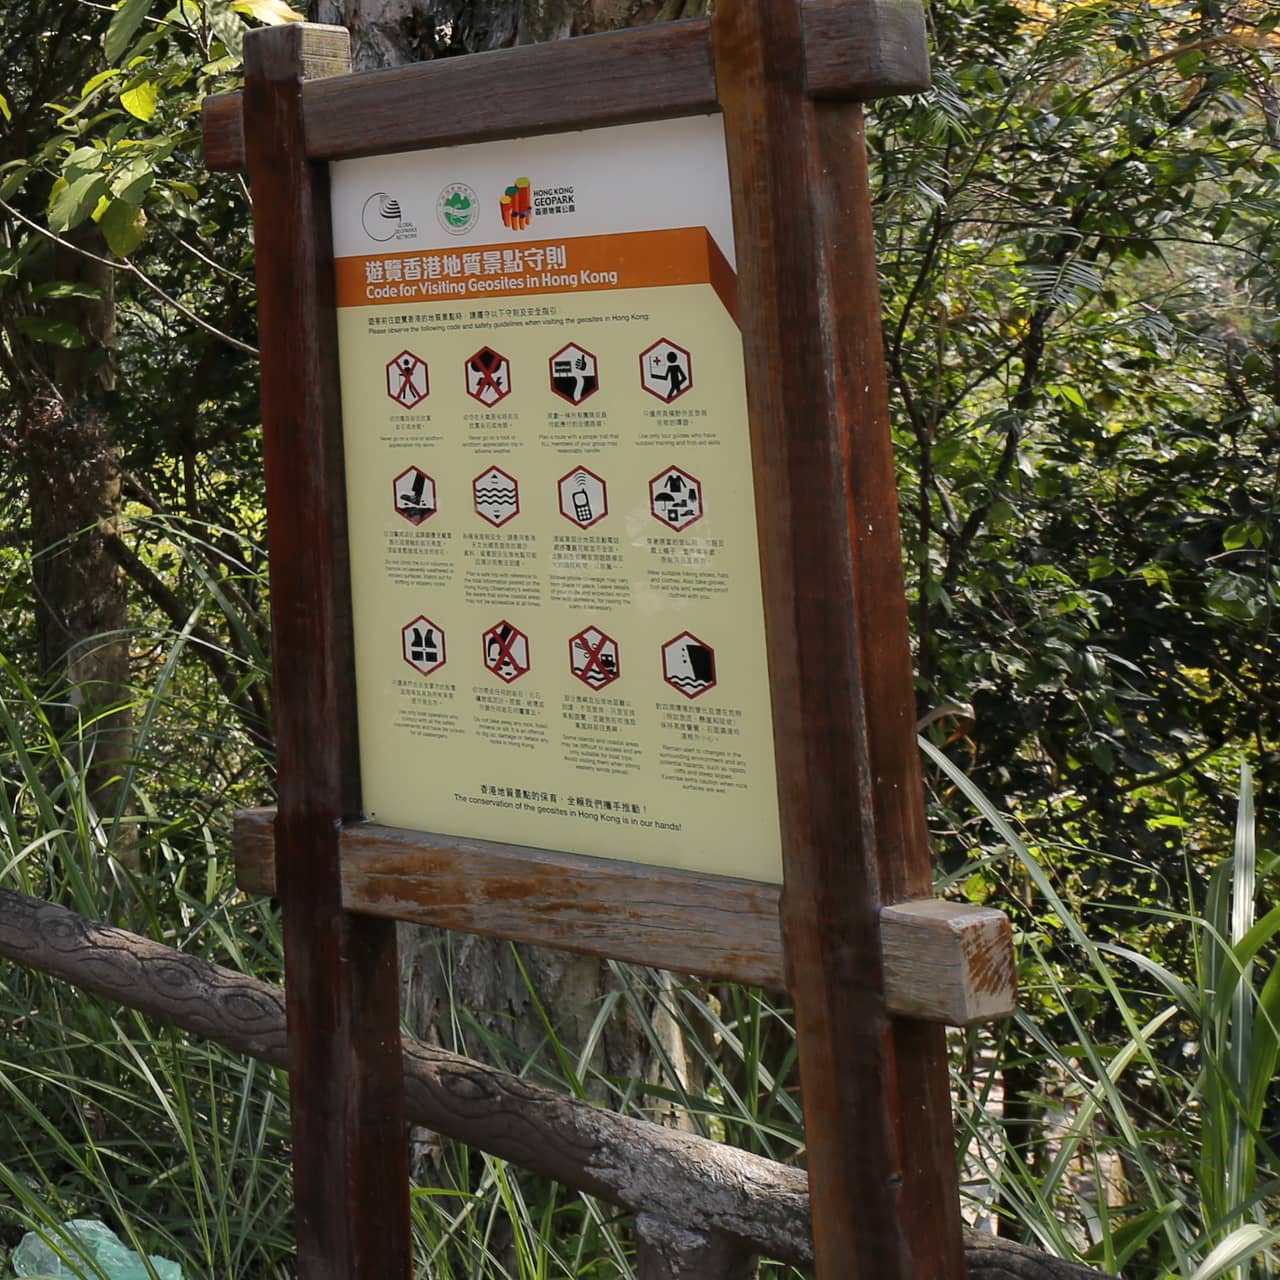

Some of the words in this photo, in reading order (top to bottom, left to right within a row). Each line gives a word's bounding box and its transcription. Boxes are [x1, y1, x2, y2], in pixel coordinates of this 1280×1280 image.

[534, 188, 553, 197] HONG
[554, 186, 574, 195] KONG
[534, 195, 575, 207] GEOPARK
[366, 245, 567, 284] 遊覽香港地質景點守則
[366, 285, 400, 299] Code
[400, 283, 417, 297] for
[419, 280, 466, 295] Visiting
[468, 276, 524, 292] Geosites
[527, 274, 539, 288] in
[542, 272, 578, 288] Hong
[580, 269, 618, 285] Kong
[454, 792, 467, 802] The
[468, 794, 513, 808] conservation
[514, 801, 522, 809] of
[523, 802, 536, 811] the
[536, 803, 568, 817] geosites
[568, 808, 577, 816] in
[577, 809, 599, 821] Hong
[599, 812, 621, 824] Kong
[621, 815, 629, 823] is
[630, 816, 638, 825] in
[639, 819, 653, 827] our
